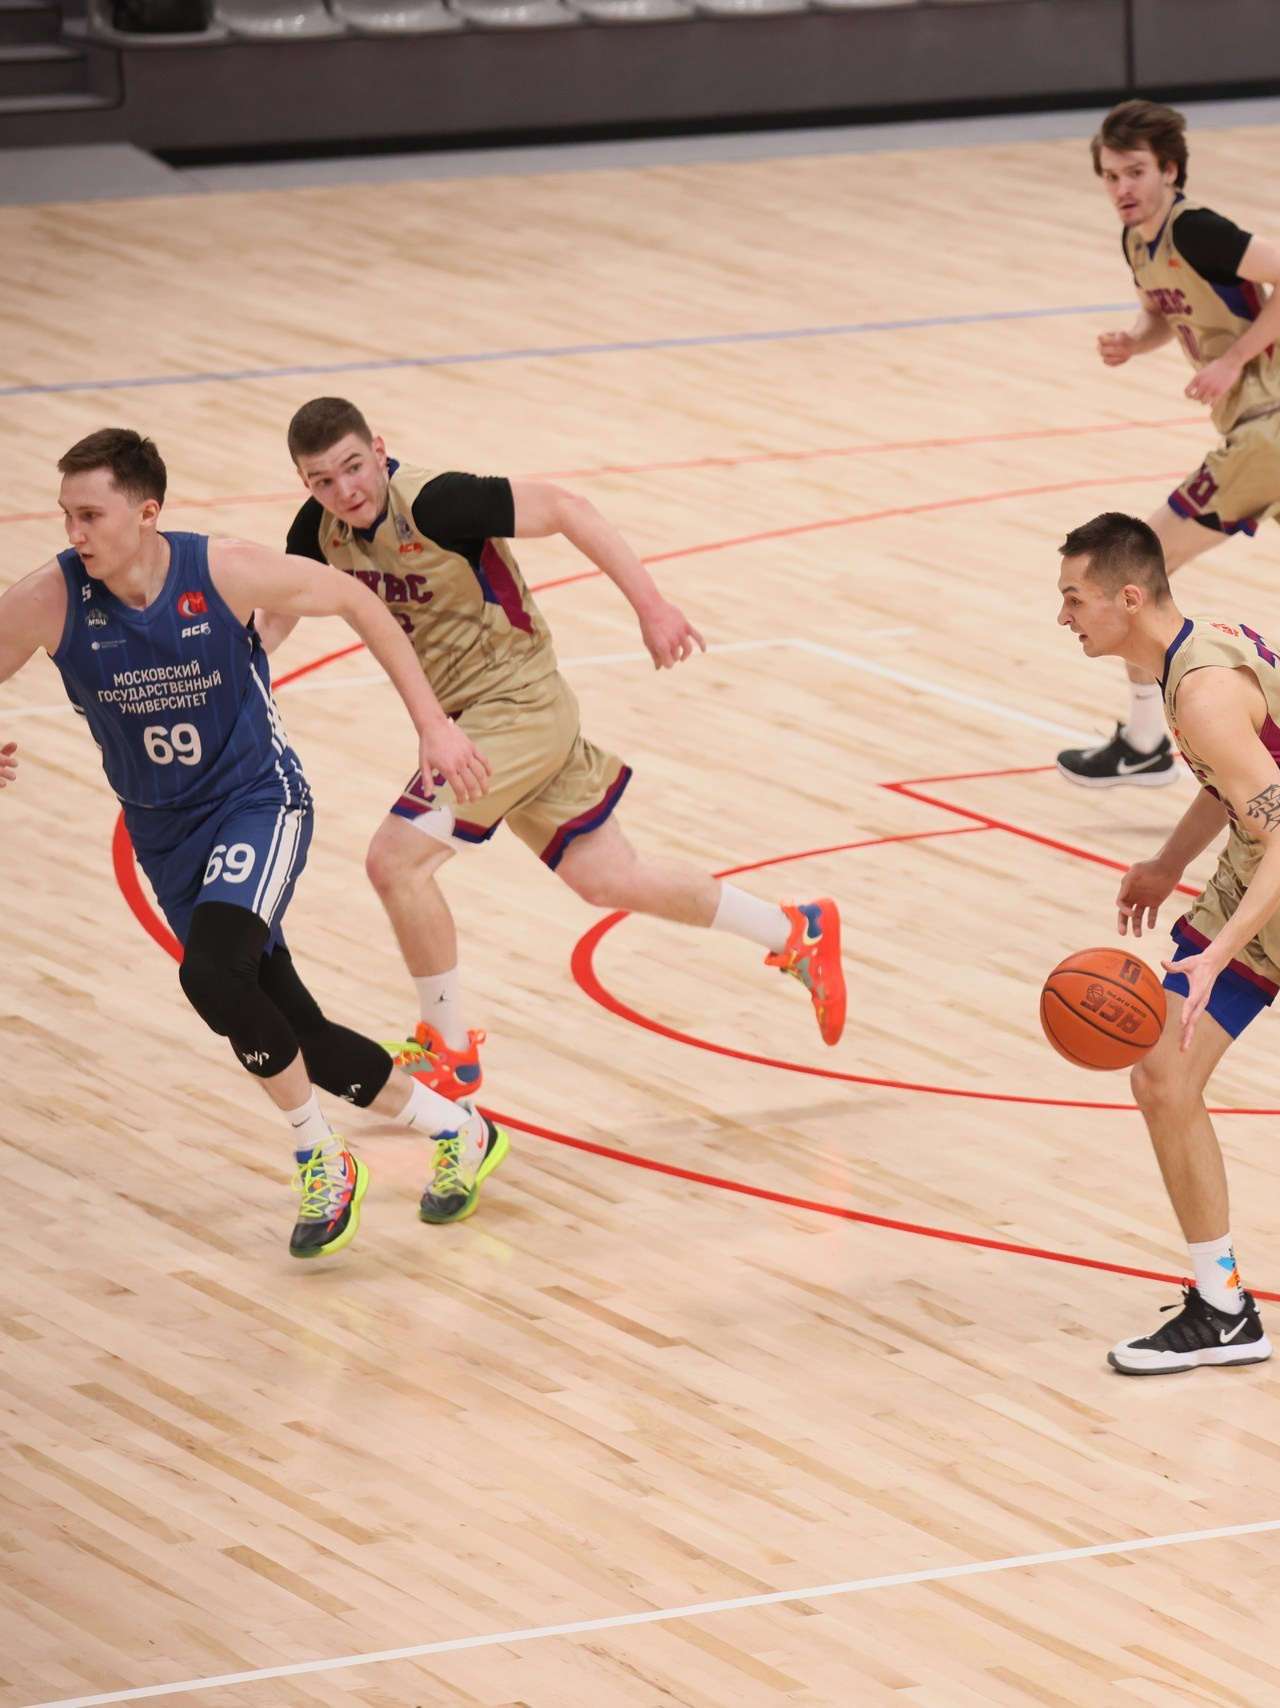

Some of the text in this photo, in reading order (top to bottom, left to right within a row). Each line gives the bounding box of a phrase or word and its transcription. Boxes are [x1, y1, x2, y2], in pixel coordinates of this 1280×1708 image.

[182, 622, 211, 638] АСБ
[98, 669, 222, 702] ГОСУДАРСТВЕННЫЙ
[113, 659, 201, 687] МОСКОВСКИЙ
[119, 692, 207, 714] УНИВЕРСИТЕТ
[144, 722, 202, 766] 69
[203, 842, 256, 886] 69
